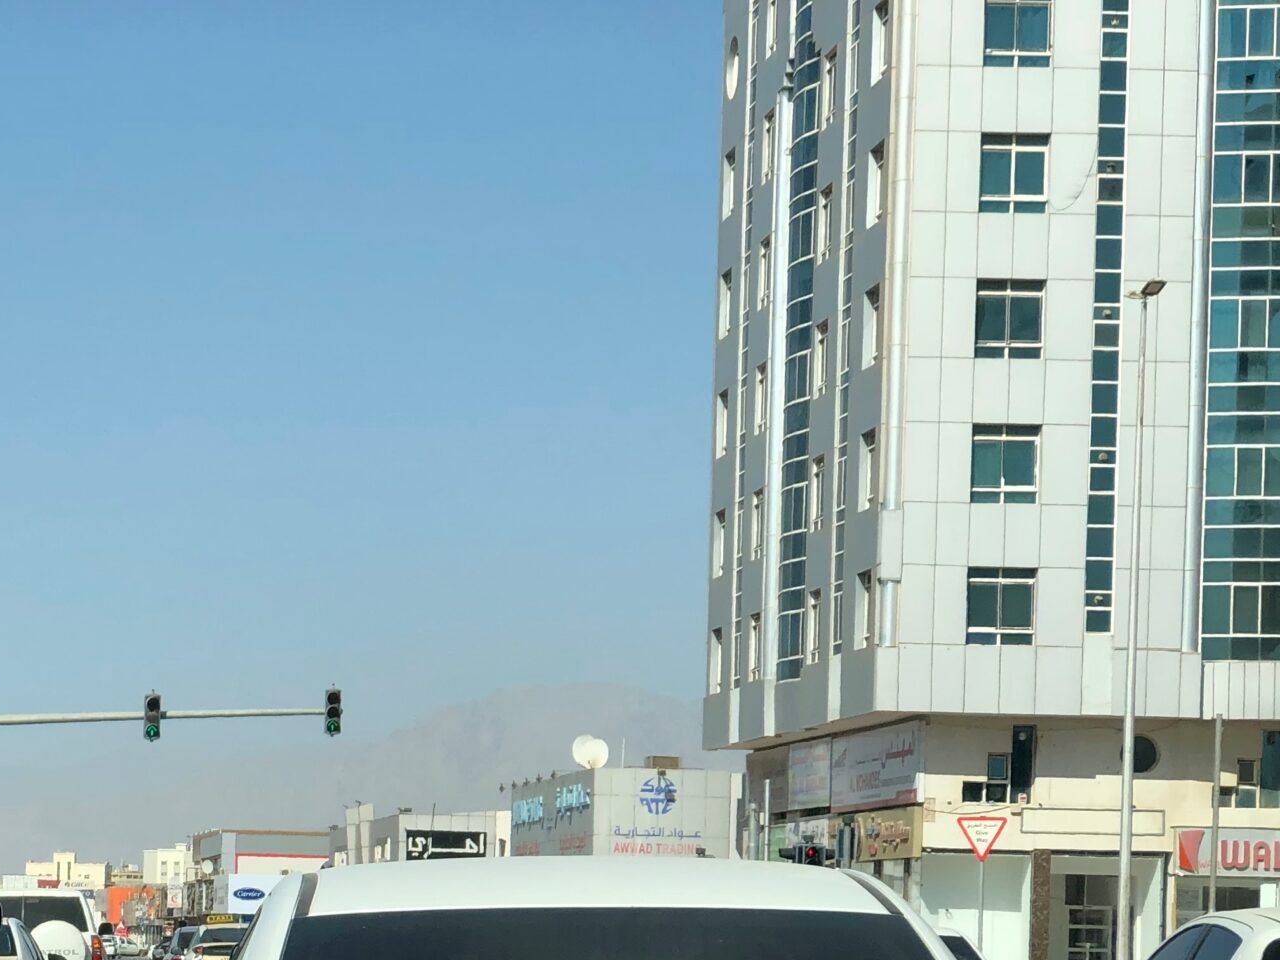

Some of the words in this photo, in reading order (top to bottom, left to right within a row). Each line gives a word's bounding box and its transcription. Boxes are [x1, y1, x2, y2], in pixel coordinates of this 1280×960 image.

[614, 825, 665, 839] التجارية
[613, 842, 653, 855] AWWAD
[236, 889, 263, 898] Carrier
